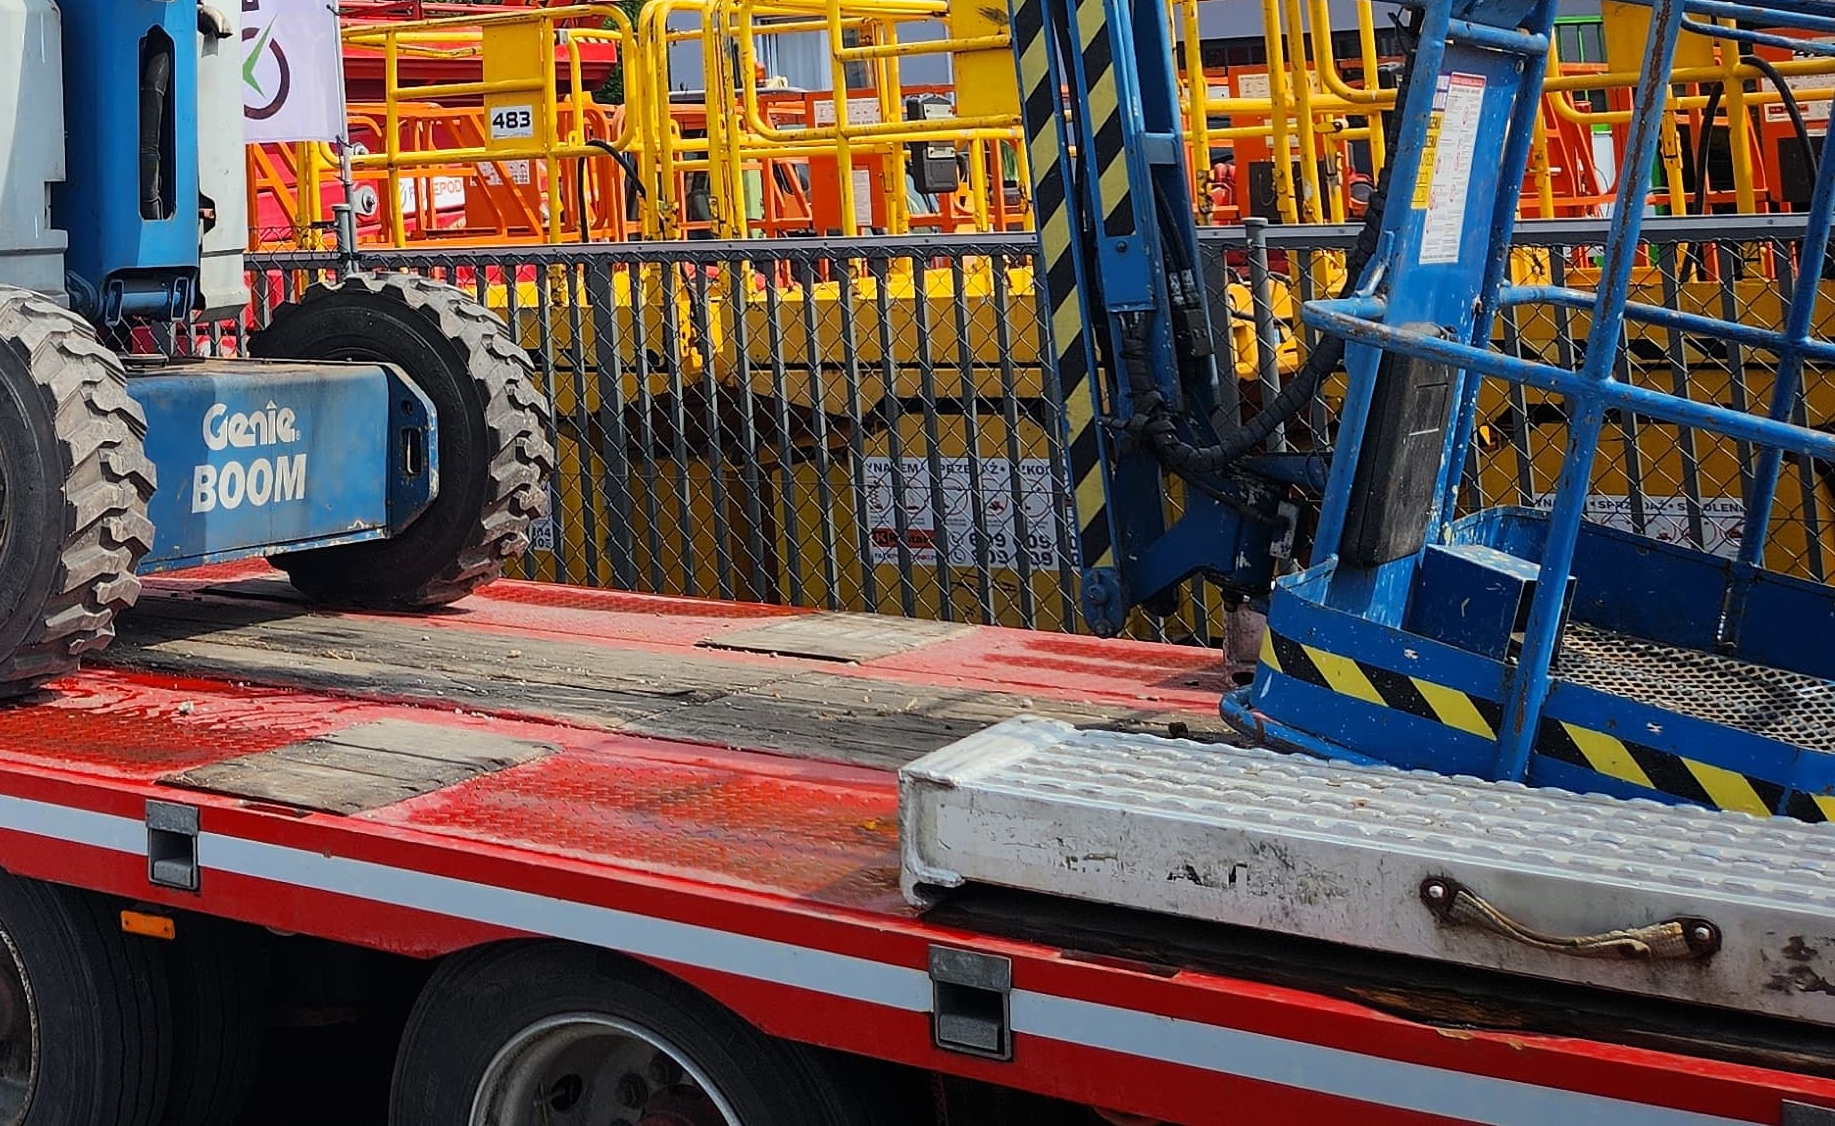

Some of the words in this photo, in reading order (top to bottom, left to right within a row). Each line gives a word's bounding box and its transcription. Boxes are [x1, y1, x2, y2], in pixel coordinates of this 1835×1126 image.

[492, 110, 531, 129] 483
[203, 399, 297, 451] Genie
[191, 453, 308, 514] BOOM
